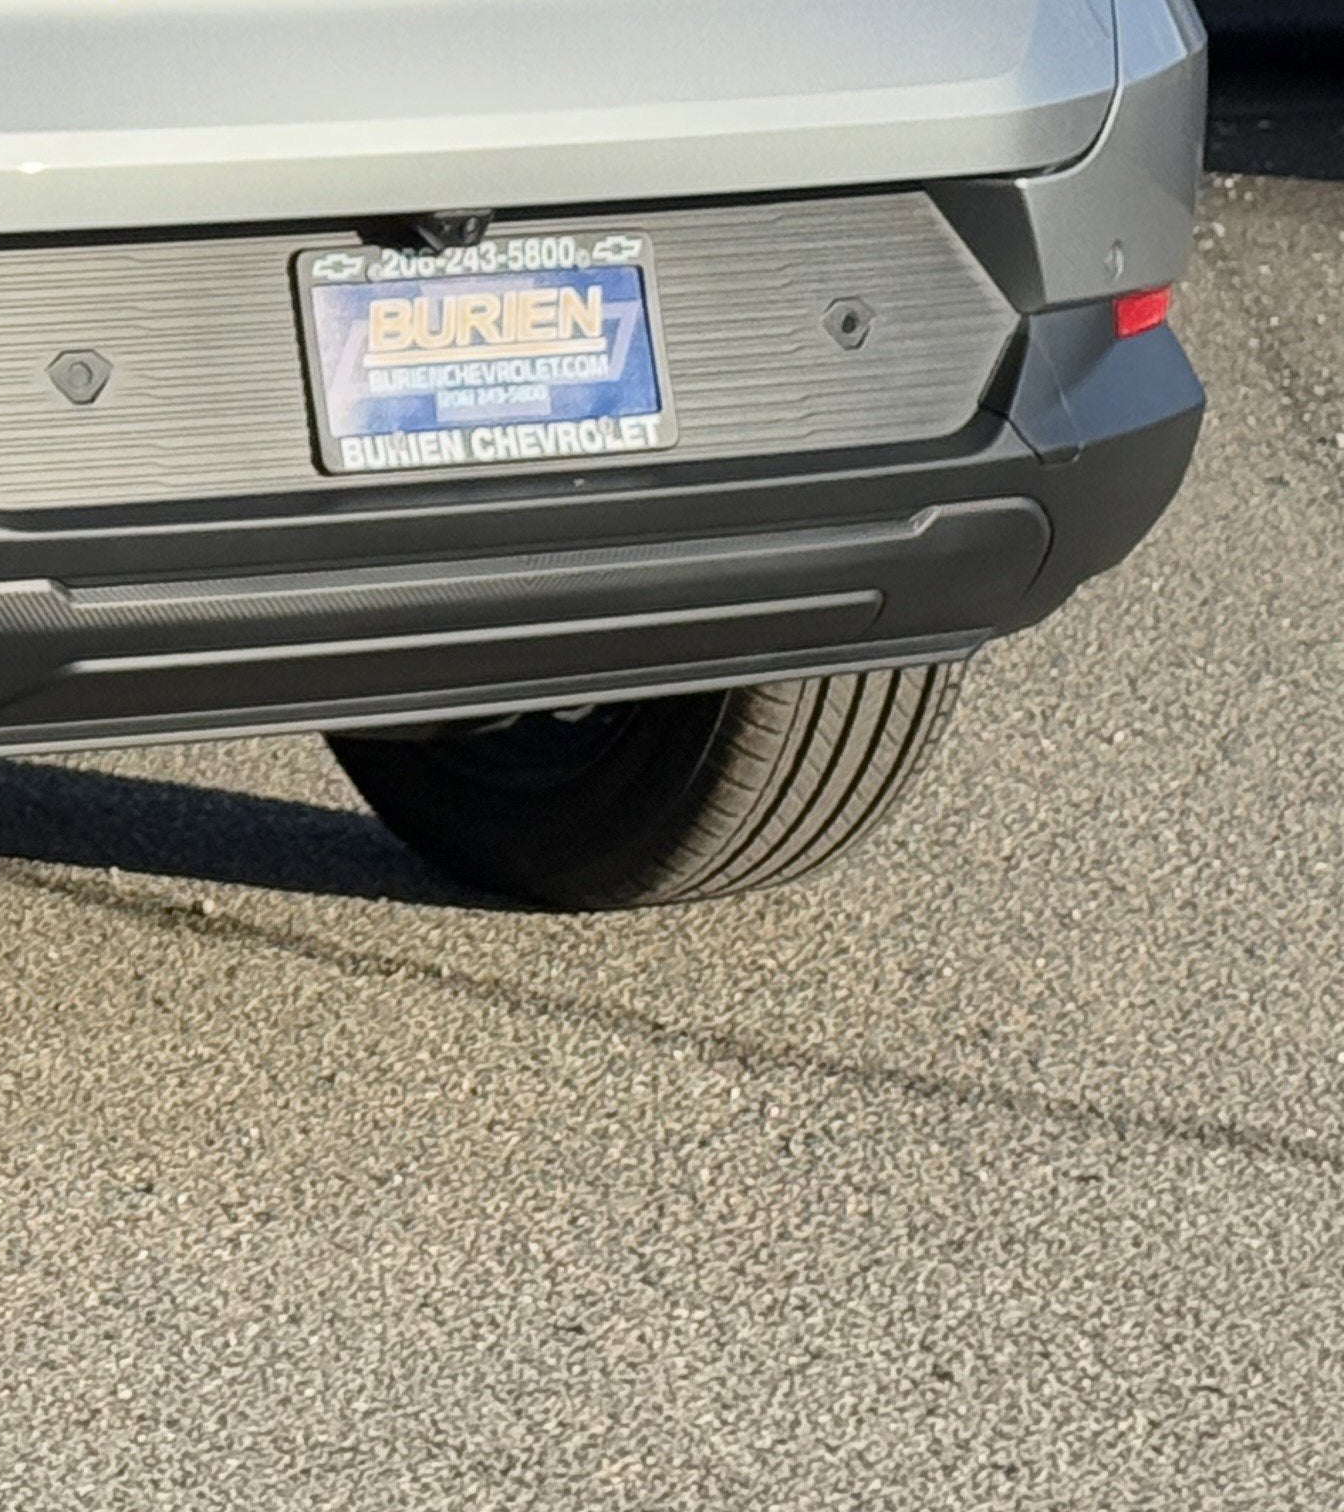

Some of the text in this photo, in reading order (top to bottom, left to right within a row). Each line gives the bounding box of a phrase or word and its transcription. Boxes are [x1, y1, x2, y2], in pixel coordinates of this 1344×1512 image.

[379, 236, 577, 278] 206-243-5800
[368, 286, 603, 351] BURIEN
[368, 356, 608, 393] BURIENCHEVROLET.COM
[340, 415, 662, 471] BURIEN CHEVROLET
